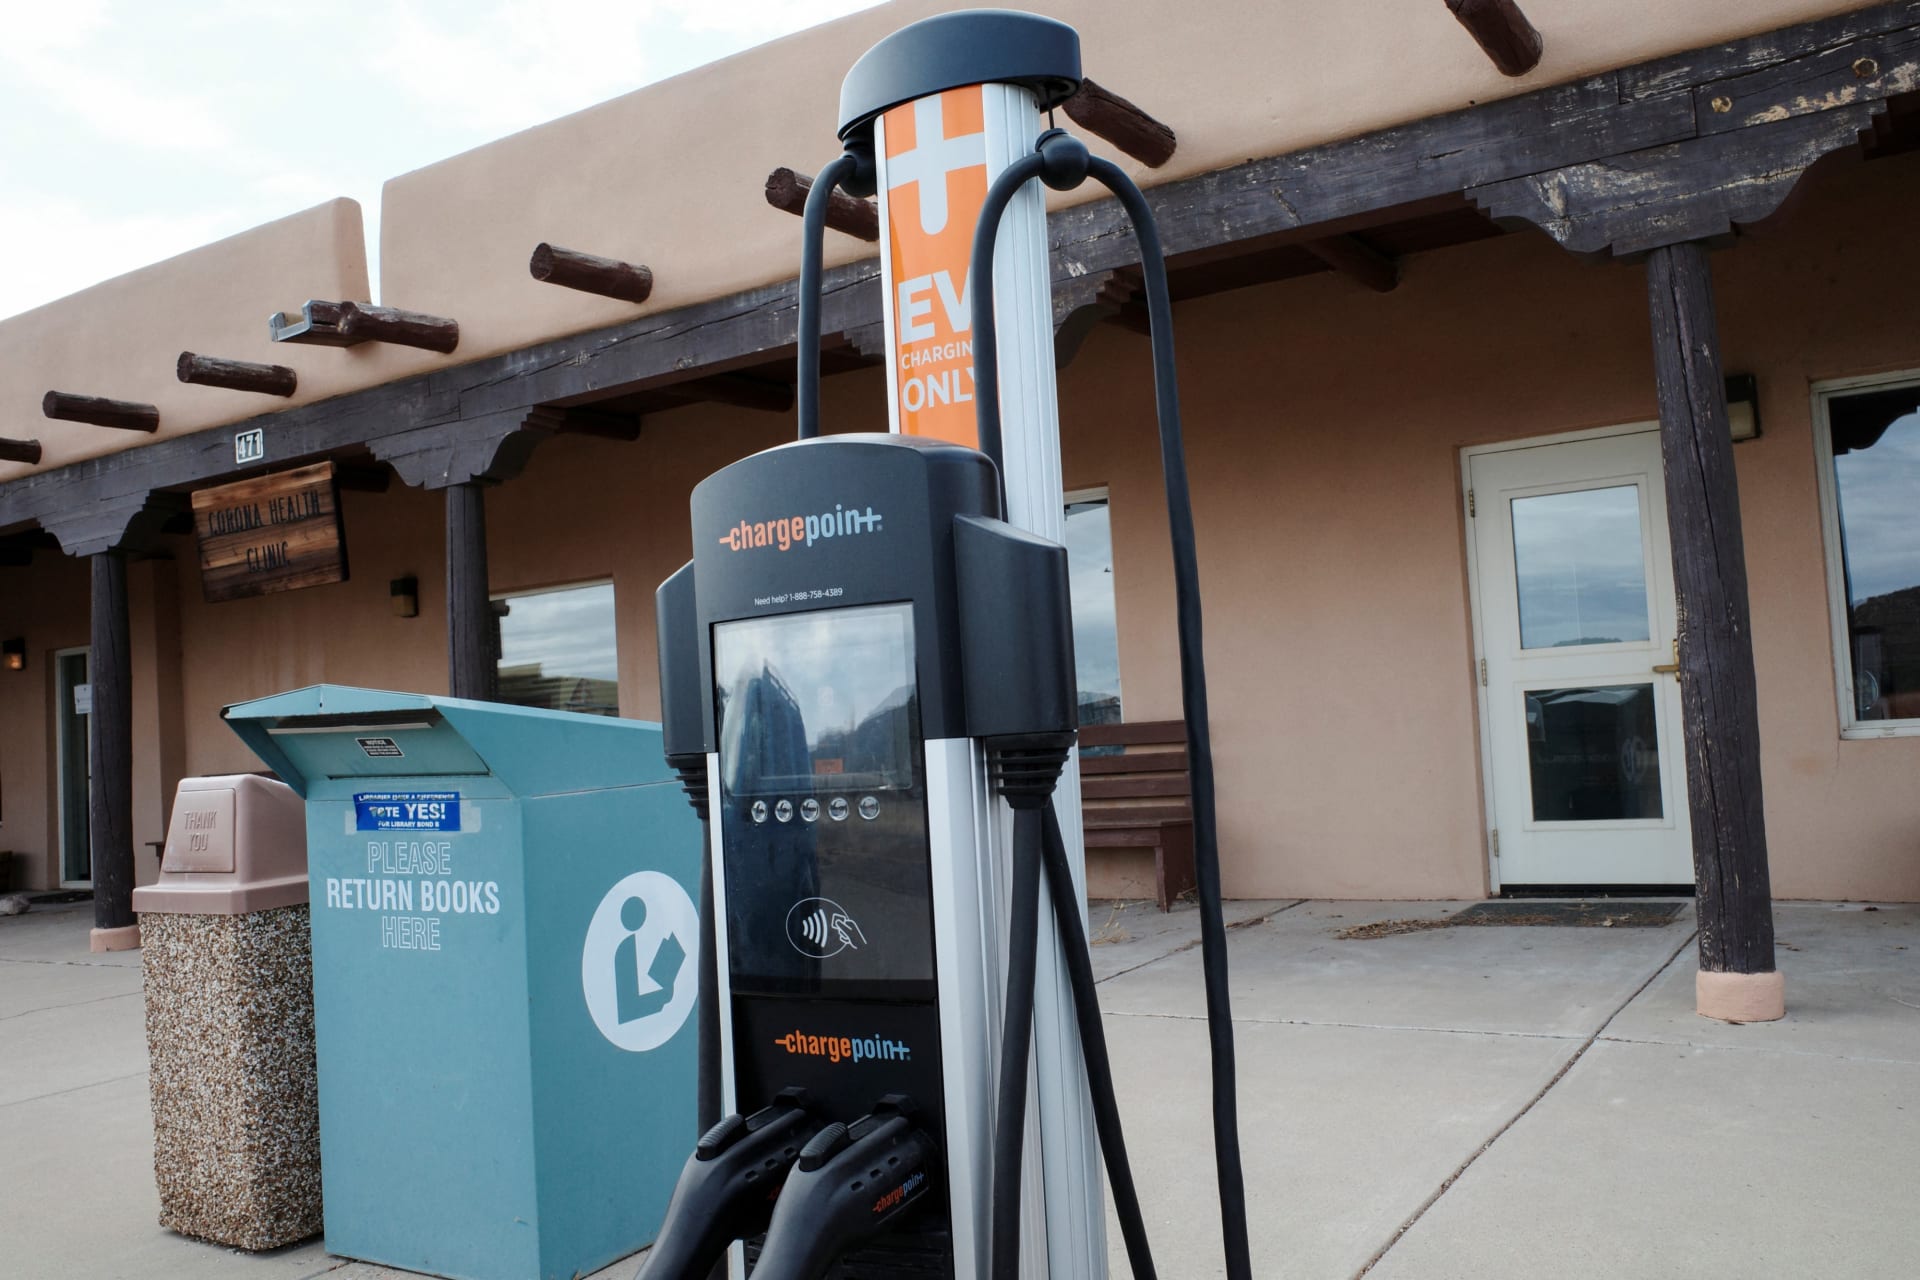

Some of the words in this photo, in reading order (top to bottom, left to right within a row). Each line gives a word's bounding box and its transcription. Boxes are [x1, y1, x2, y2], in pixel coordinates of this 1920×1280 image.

[898, 265, 973, 344] EV
[901, 339, 974, 370] CHARGIN
[903, 366, 975, 413] ONL
[238, 433, 261, 458] 471
[208, 503, 264, 537] CORONA
[268, 491, 322, 525] HEALTH
[246, 541, 291, 574] CLINIC
[754, 596, 771, 606] Need
[771, 594, 789, 605] help?
[789, 587, 844, 602] 1-888-758-4389
[184, 810, 218, 830] THANK
[405, 803, 446, 820] YES!
[189, 833, 209, 851] YOU
[367, 841, 452, 875] PLEASE
[326, 878, 413, 911] RETURN
[421, 880, 501, 914] BOOKS
[382, 916, 441, 950] HERE
